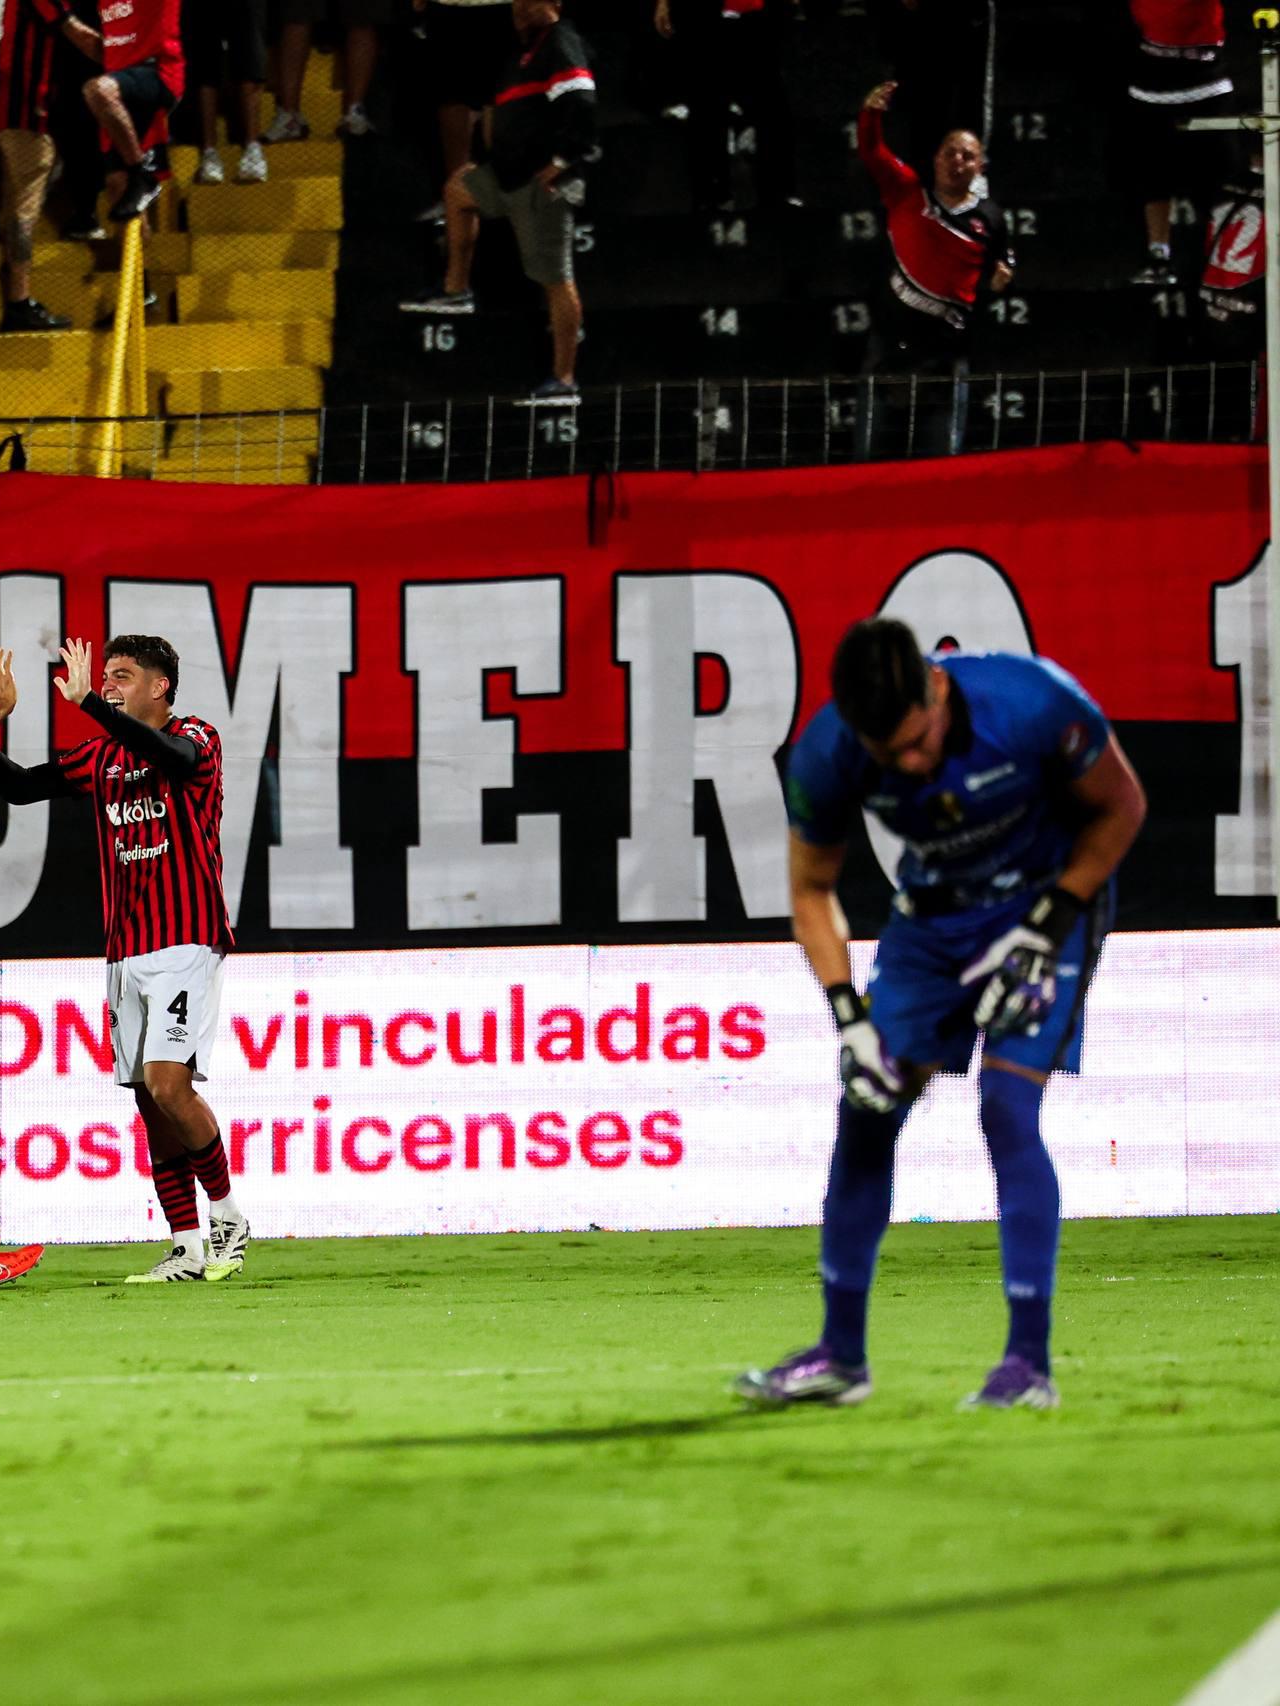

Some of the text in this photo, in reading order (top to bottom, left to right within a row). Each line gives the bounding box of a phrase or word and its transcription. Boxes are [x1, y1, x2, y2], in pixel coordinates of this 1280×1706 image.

[422, 324, 455, 351] 16
[701, 308, 739, 336] 14
[166, 989, 189, 1026] 4
[231, 982, 768, 1071] vinculadas
